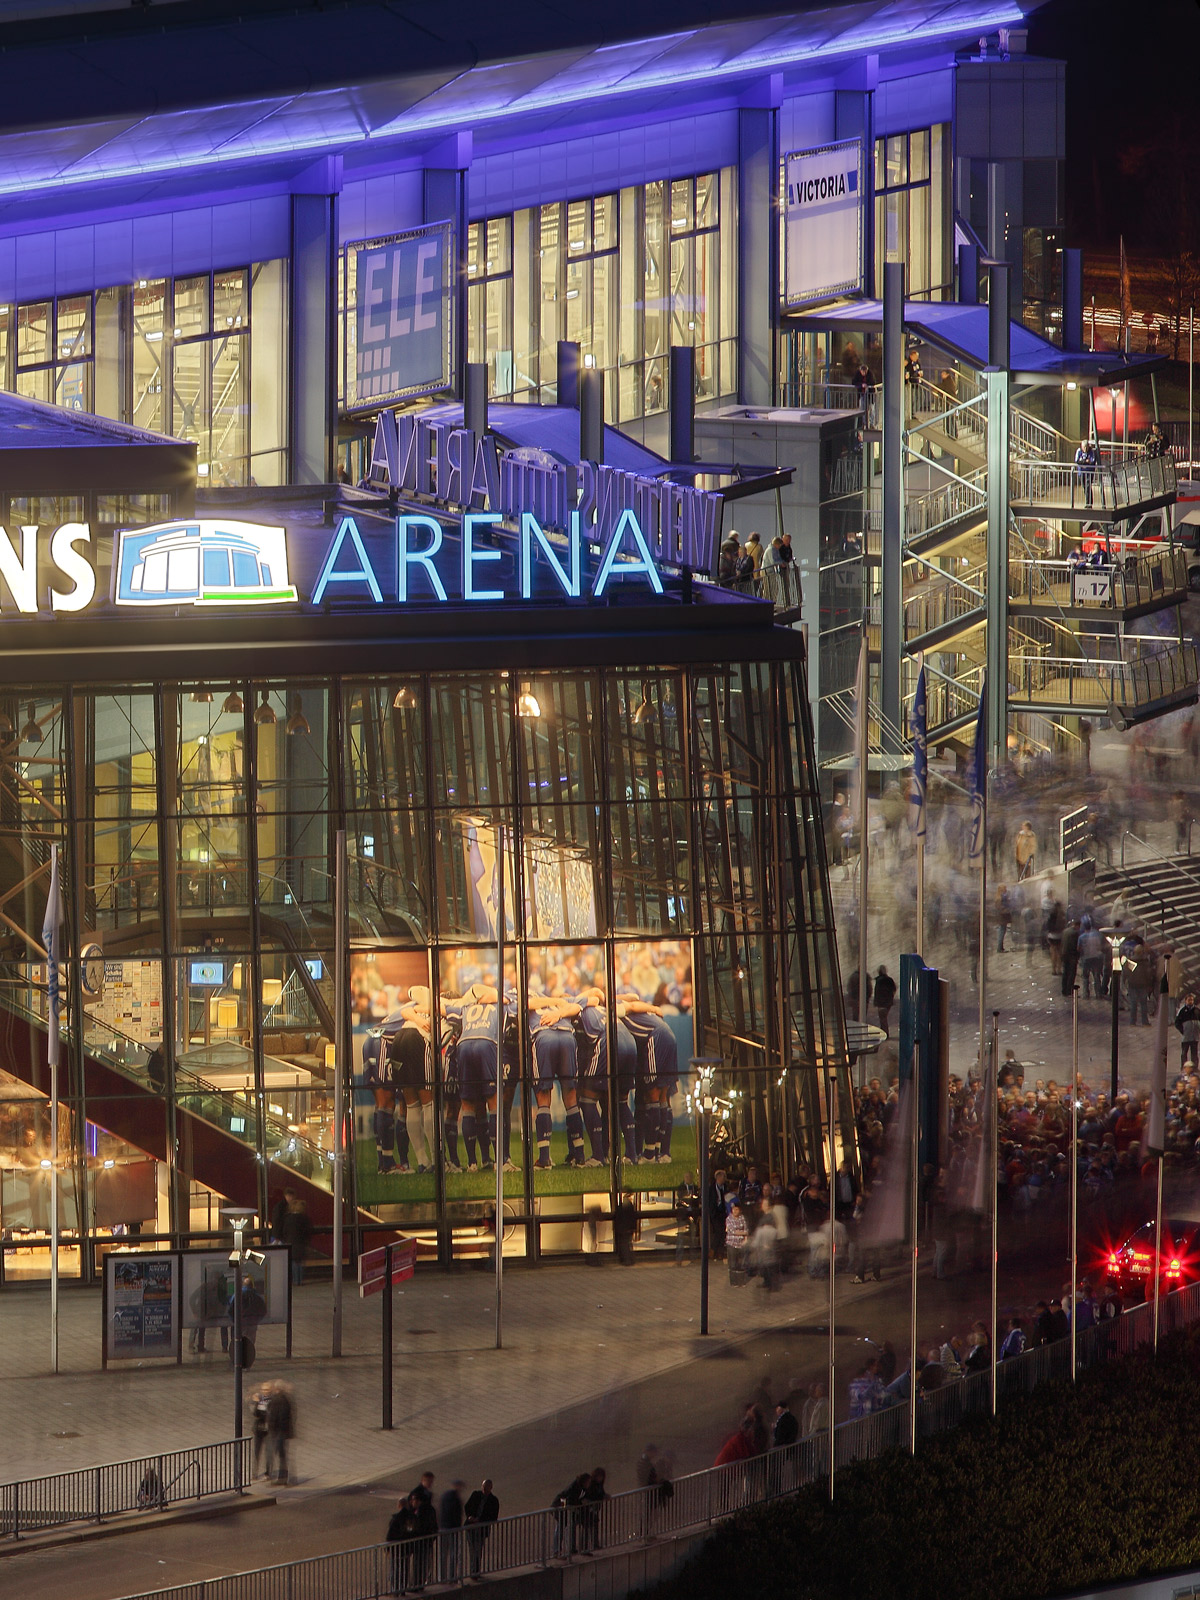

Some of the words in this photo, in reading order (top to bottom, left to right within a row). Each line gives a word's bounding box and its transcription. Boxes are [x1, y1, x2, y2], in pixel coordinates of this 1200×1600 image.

[796, 173, 846, 204] VICTORIA
[362, 241, 438, 344] ELE
[311, 508, 665, 605] ARENA
[1090, 582, 1109, 596] 17
